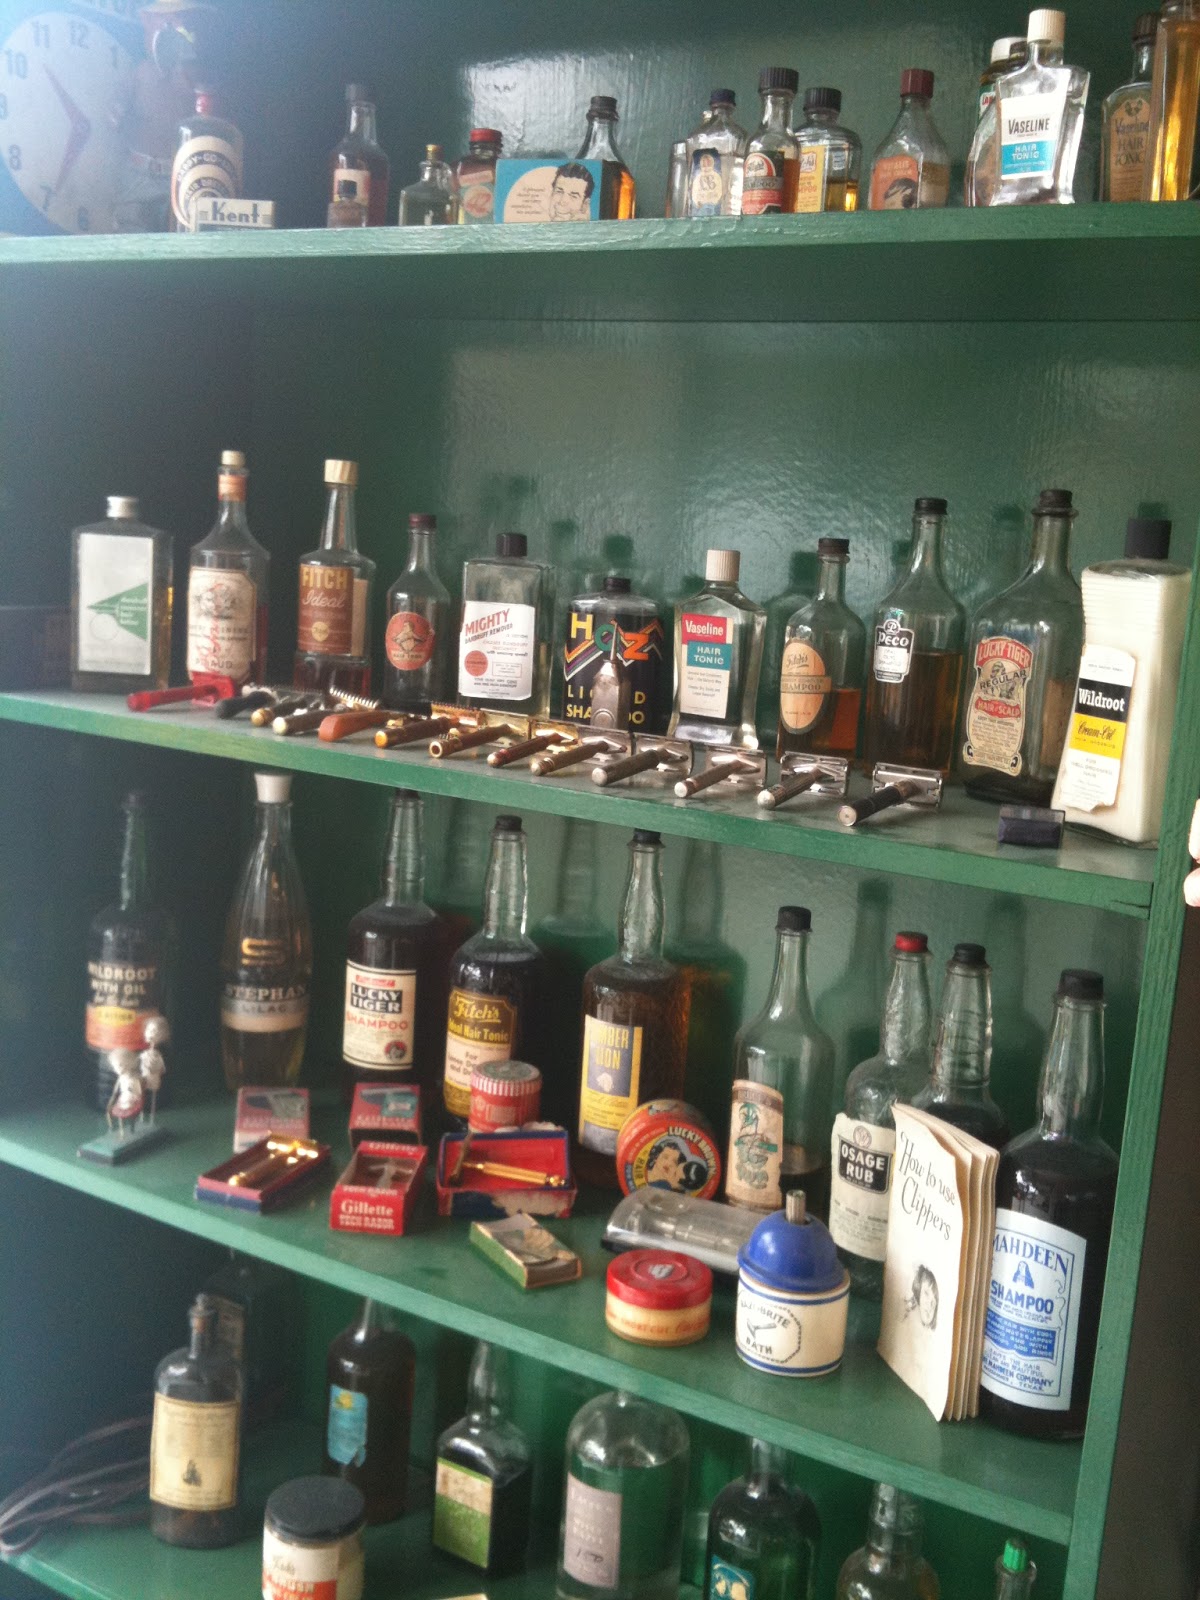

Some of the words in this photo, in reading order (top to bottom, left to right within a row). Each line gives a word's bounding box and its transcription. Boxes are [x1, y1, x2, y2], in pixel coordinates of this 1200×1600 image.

[1007, 117, 1050, 135] VASELINE
[1014, 144, 1037, 154] HAIR
[1118, 136, 1144, 152] HAIR
[8, 145, 22, 171] 8
[1011, 151, 1039, 161] TONIC
[211, 201, 259, 224] Kent
[302, 566, 348, 590] FITCH
[302, 589, 346, 609] Ideal
[465, 608, 510, 637] MIGHTY
[685, 619, 724, 636] Vaseline
[694, 655, 724, 665] TONIC
[697, 646, 721, 656] HAIR
[979, 641, 1006, 661] LUCKY
[1007, 642, 1031, 668] TIGER
[980, 669, 1027, 690] REGULAR
[1078, 687, 1126, 713] Wildroot
[352, 984, 400, 1001] LUCKY
[351, 995, 401, 1013] TIGER
[453, 996, 501, 1020] Fitch's
[346, 1010, 409, 1031] SHAMPOO
[464, 1024, 482, 1040] Hair
[483, 1028, 509, 1043] Tonic
[668, 1125, 701, 1144] LUCKY
[841, 1143, 886, 1172] OSAGE
[846, 1162, 874, 1184] RUB
[899, 1130, 925, 1177] How
[926, 1161, 937, 1188] to
[938, 1178, 956, 1206] use
[340, 1199, 395, 1217] Gillette
[901, 1175, 952, 1241] Clippers
[993, 1233, 1070, 1277] MAHDEEN
[990, 1279, 1055, 1315] SHAMPOO
[745, 1336, 772, 1355] BATH
[1015, 1373, 1055, 1387] COMPANY
